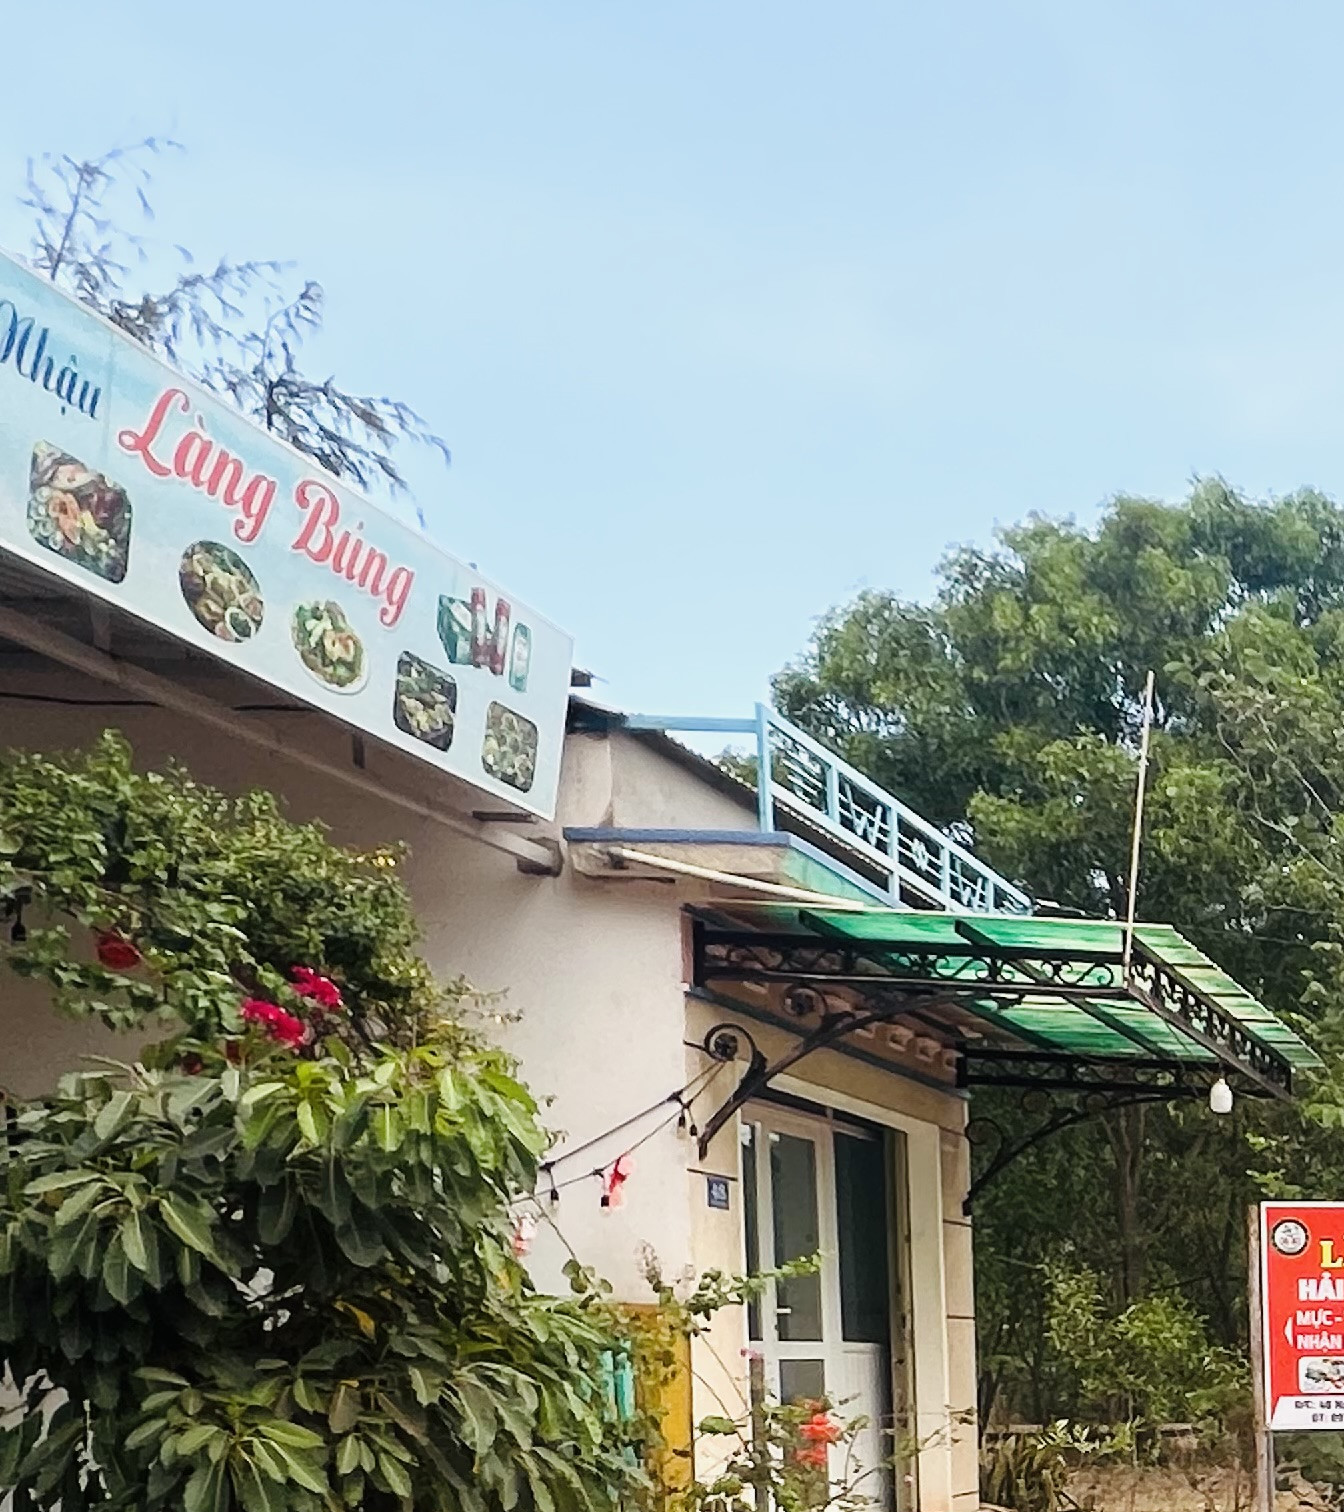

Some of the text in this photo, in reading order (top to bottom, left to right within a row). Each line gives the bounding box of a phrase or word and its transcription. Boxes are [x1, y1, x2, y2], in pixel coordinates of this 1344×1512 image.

[118, 388, 277, 543] Làng
[291, 478, 416, 628] Búng
[1297, 1271, 1344, 1301] HẢI
[1296, 1308, 1333, 1329] MỰC
[1297, 1331, 1343, 1352] NHẬN
